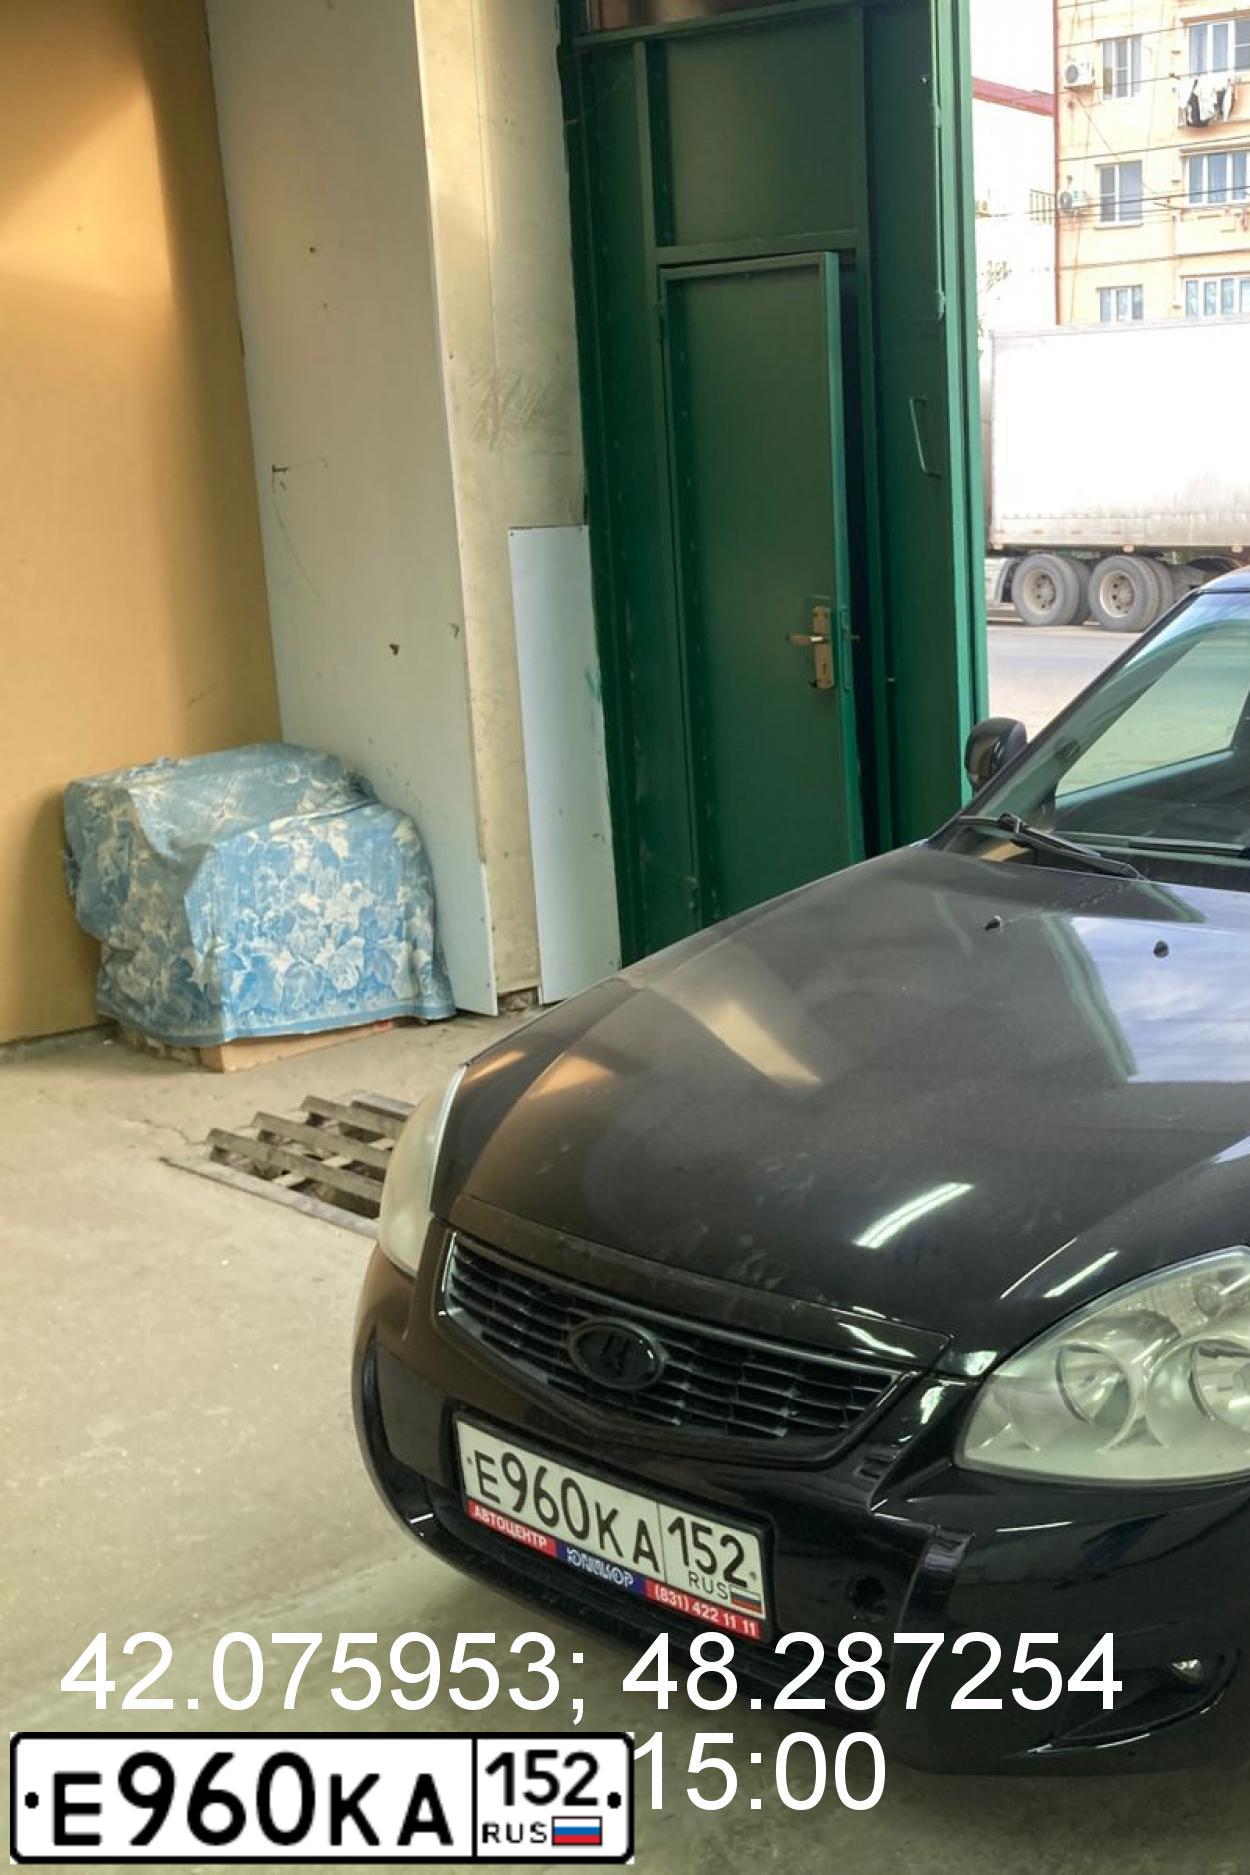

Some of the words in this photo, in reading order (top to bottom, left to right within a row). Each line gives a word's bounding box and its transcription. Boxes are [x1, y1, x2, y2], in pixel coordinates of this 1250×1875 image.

[474, 1503, 549, 1550] АВТОЦЕНТР
[654, 1583, 690, 1613] (831)
[692, 1600, 720, 1623] 422
[723, 1612, 738, 1630] 11
[742, 1619, 757, 1638] 11
[475, 1449, 660, 1573] Е960КА
[667, 1515, 748, 1589] 152
[688, 1571, 729, 1600] RUS
